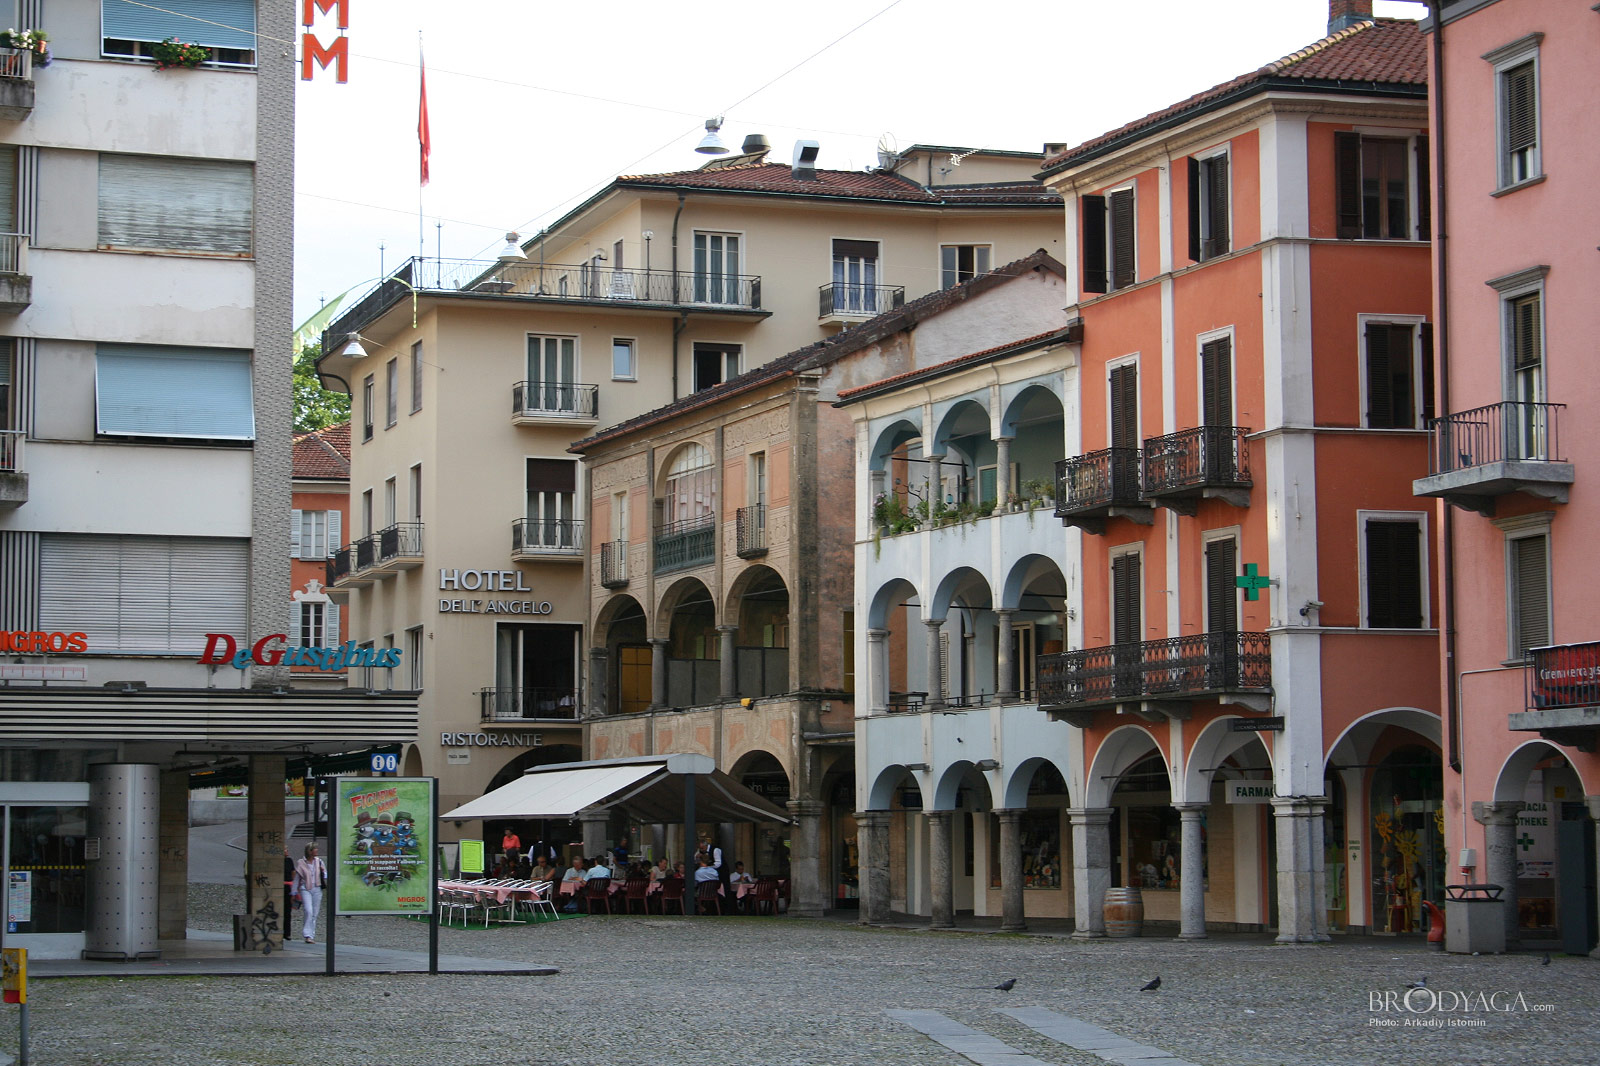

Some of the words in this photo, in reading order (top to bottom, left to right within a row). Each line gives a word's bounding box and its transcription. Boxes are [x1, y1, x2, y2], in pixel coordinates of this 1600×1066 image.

[439, 568, 532, 592] HOTEL
[485, 600, 552, 615] ANGELO
[441, 731, 543, 747] RISTORANTE
